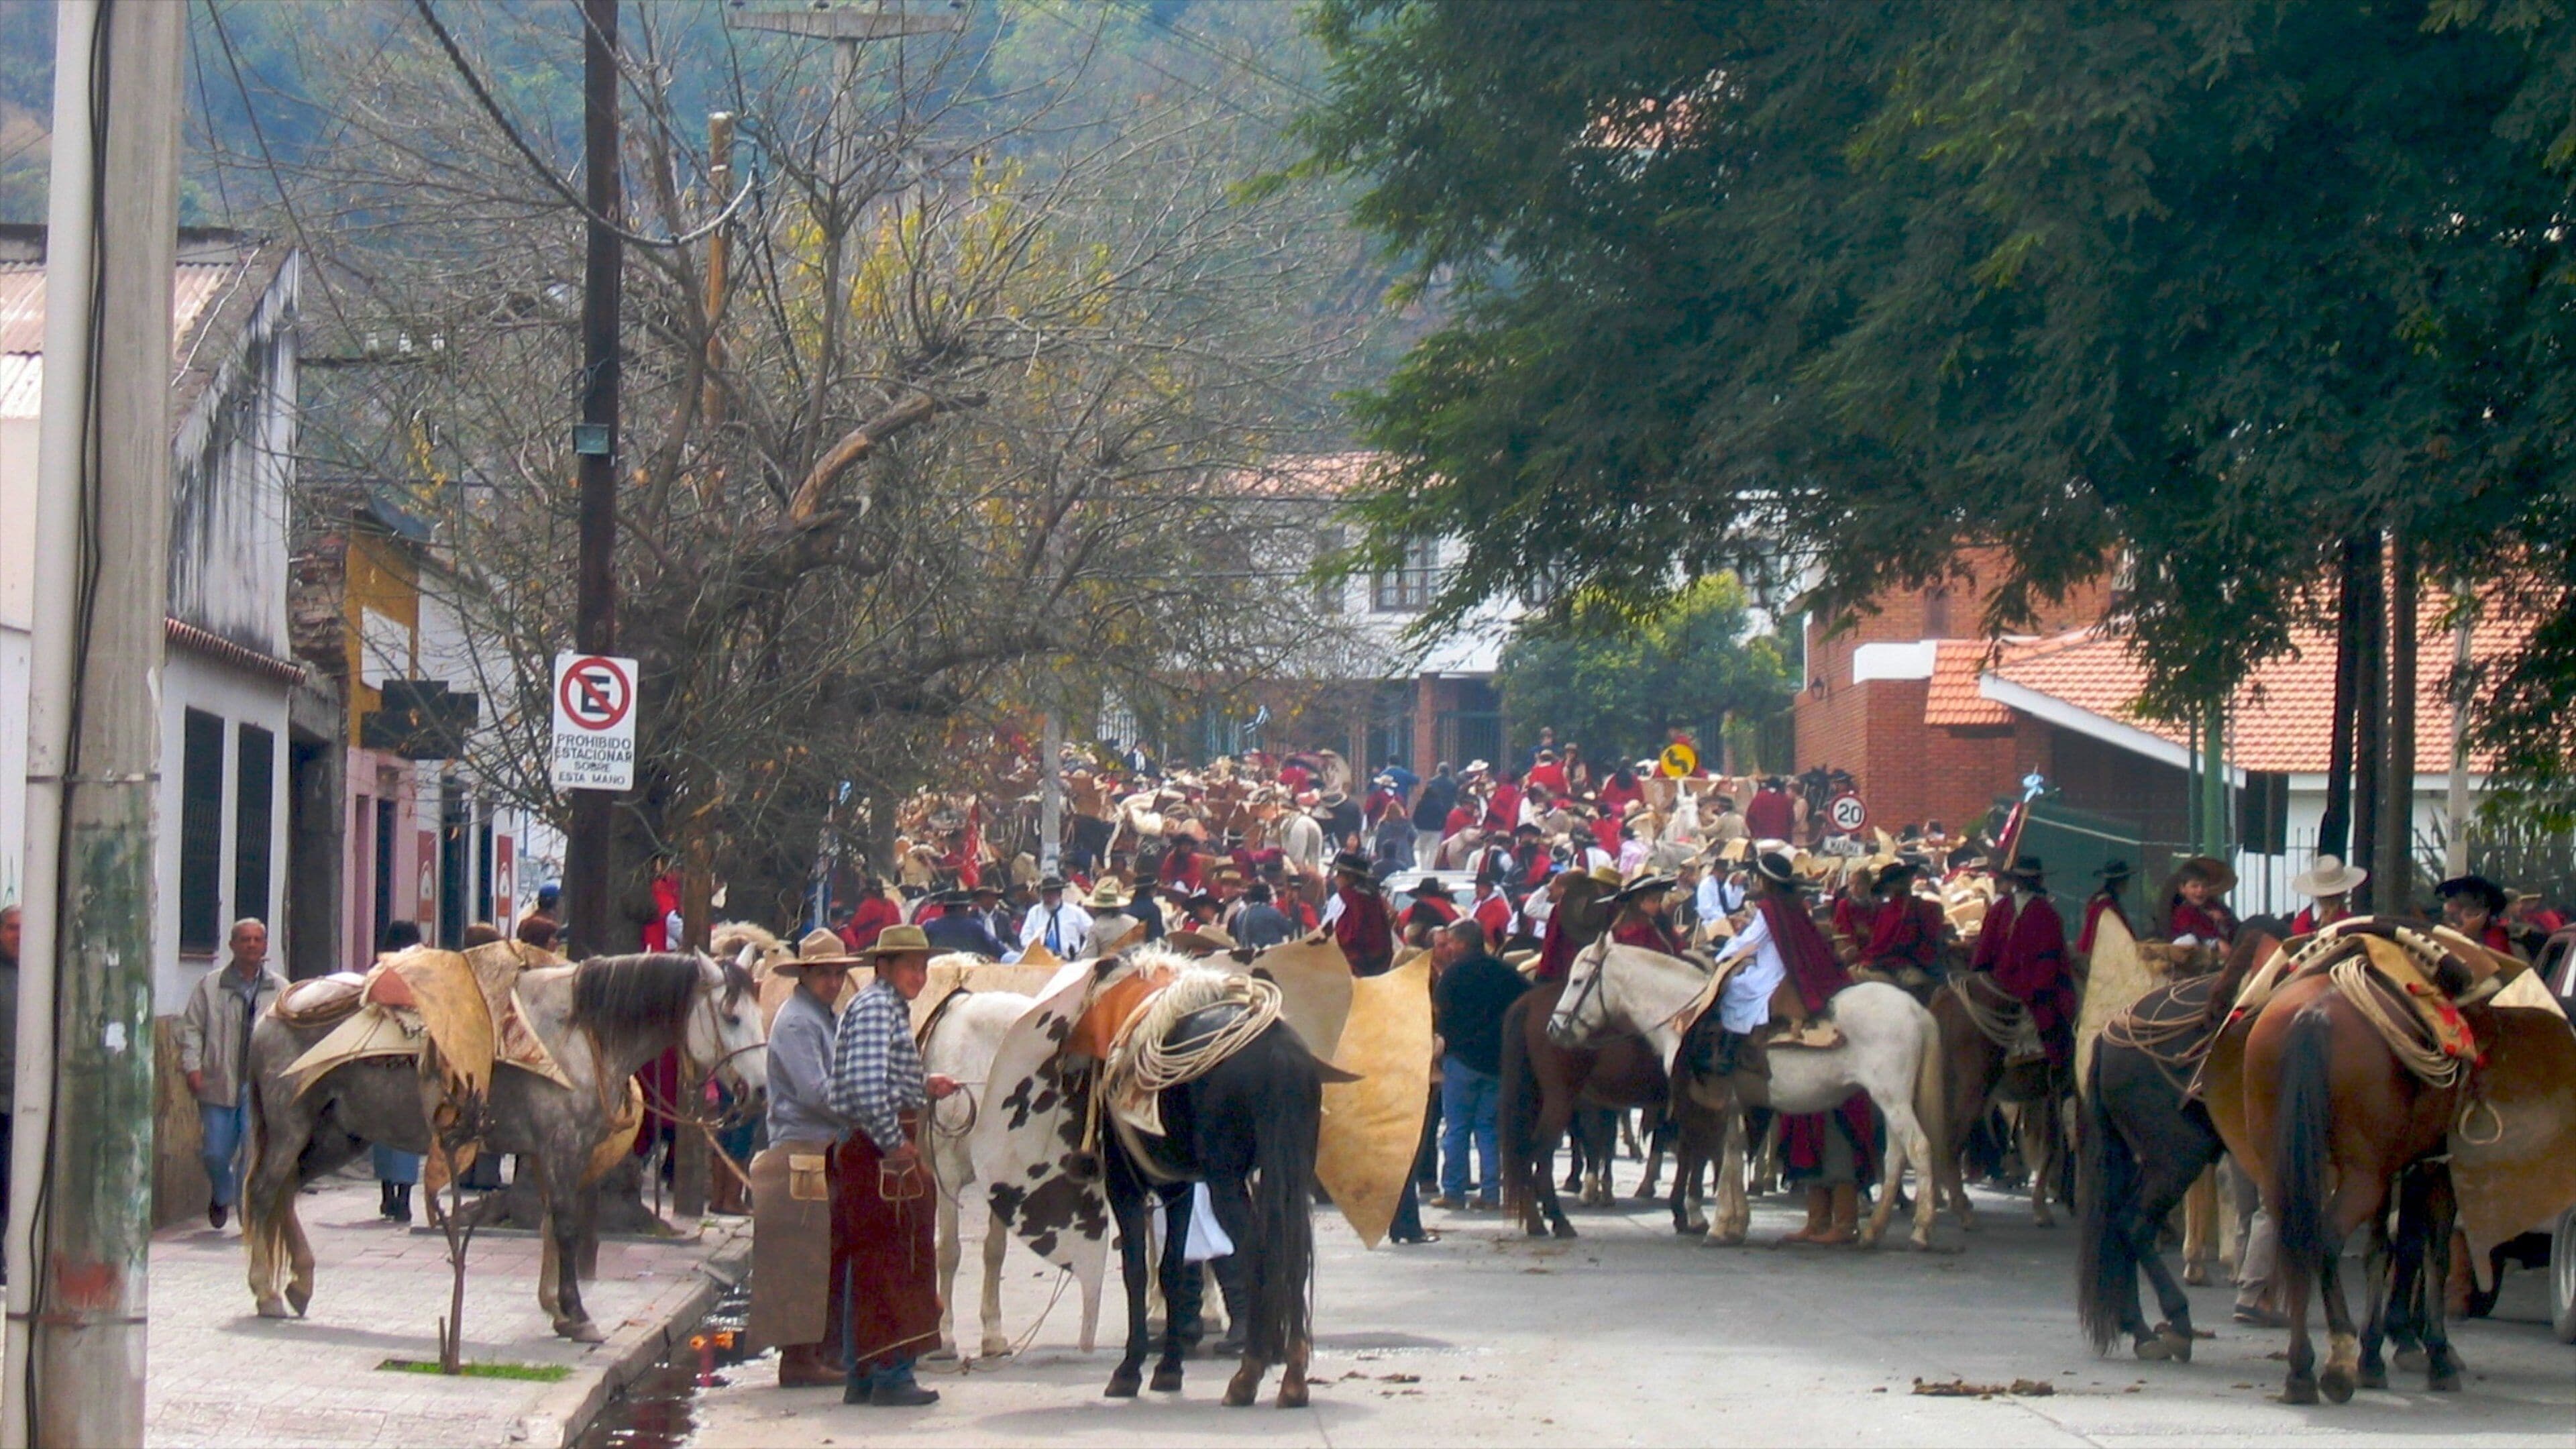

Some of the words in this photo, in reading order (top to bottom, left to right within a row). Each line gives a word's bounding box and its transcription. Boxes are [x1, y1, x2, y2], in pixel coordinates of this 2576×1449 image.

[581, 675, 610, 713] E
[557, 734, 631, 749] PROHIBIDO
[555, 747, 632, 762] ESTACIONAR
[559, 772, 585, 782] ESTA
[592, 774, 625, 784] MANO
[1838, 804, 1862, 823] 20
